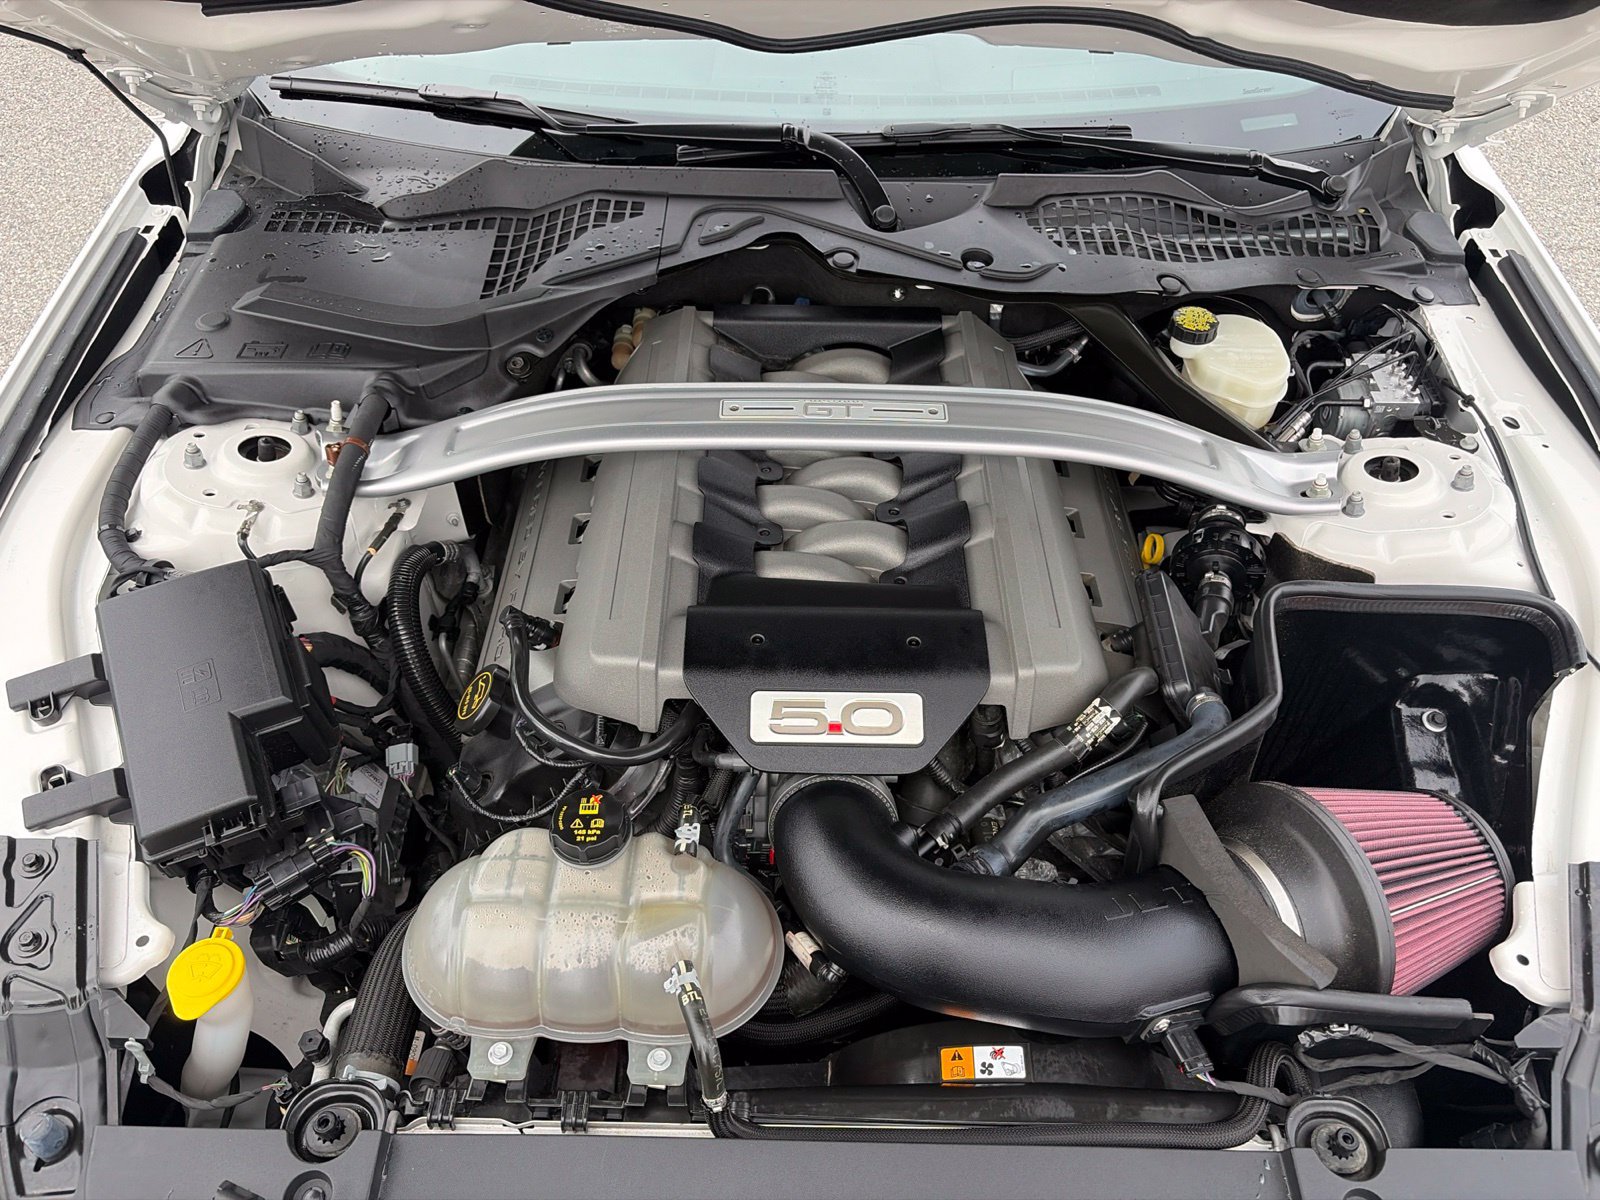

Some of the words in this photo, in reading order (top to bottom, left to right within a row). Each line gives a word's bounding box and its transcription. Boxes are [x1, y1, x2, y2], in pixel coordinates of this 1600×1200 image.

[802, 403, 864, 418] GT
[769, 699, 904, 736] 5.0
[681, 990, 703, 1006] BTL
